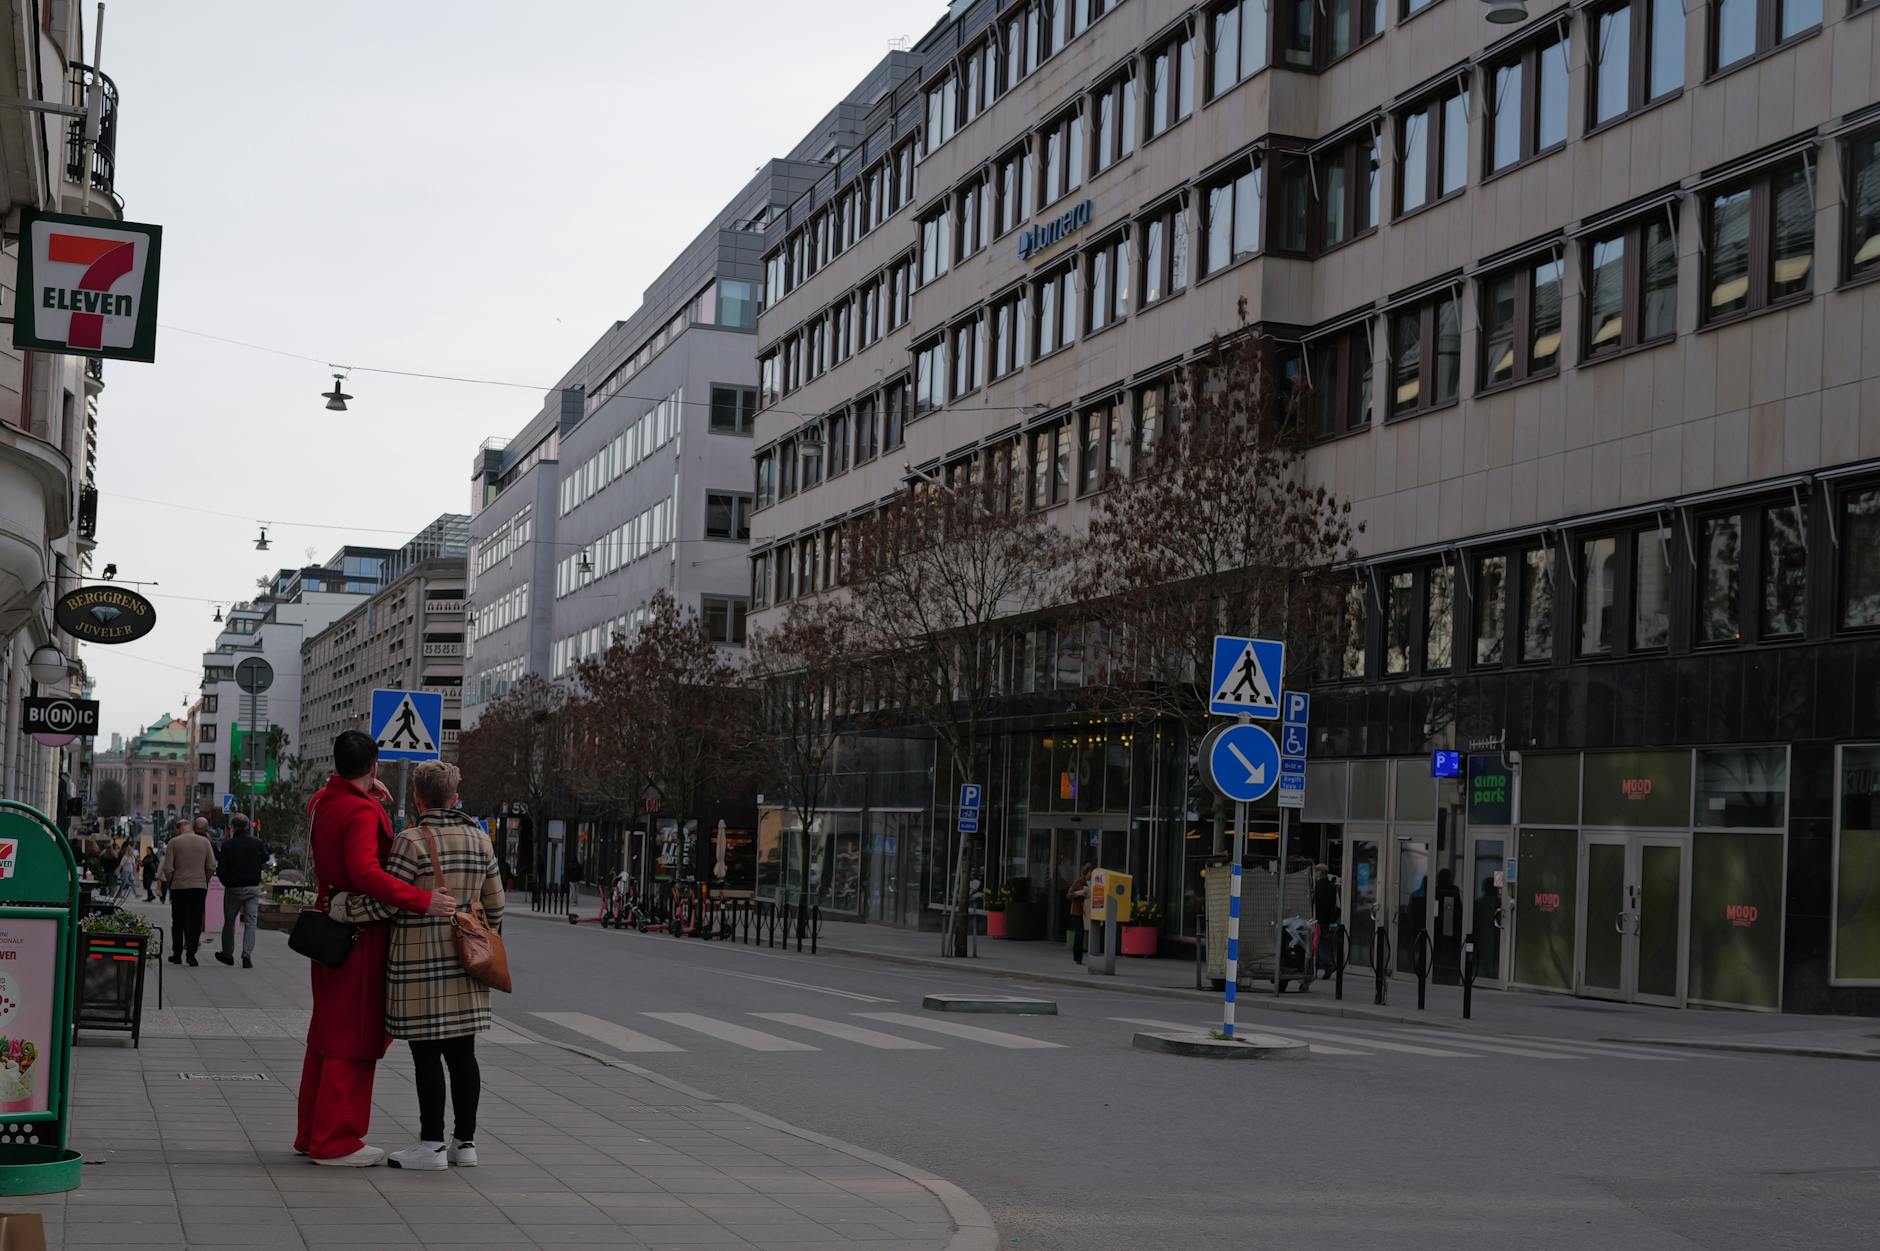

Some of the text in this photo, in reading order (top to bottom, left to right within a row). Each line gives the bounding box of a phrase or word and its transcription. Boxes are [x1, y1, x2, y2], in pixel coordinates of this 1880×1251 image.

[1032, 199, 1091, 254] Lumera
[66, 591, 147, 617] BERGGRENS
[74, 621, 134, 637] JUVELER
[29, 706, 94, 725] BIONIC
[1289, 695, 1305, 721] P
[1474, 775, 1507, 788] aimo
[1622, 778, 1652, 795] MOOD
[965, 786, 978, 806] P
[1474, 788, 1505, 806] park
[1535, 892, 1560, 908] MOOD
[1726, 904, 1758, 922] MOOD
